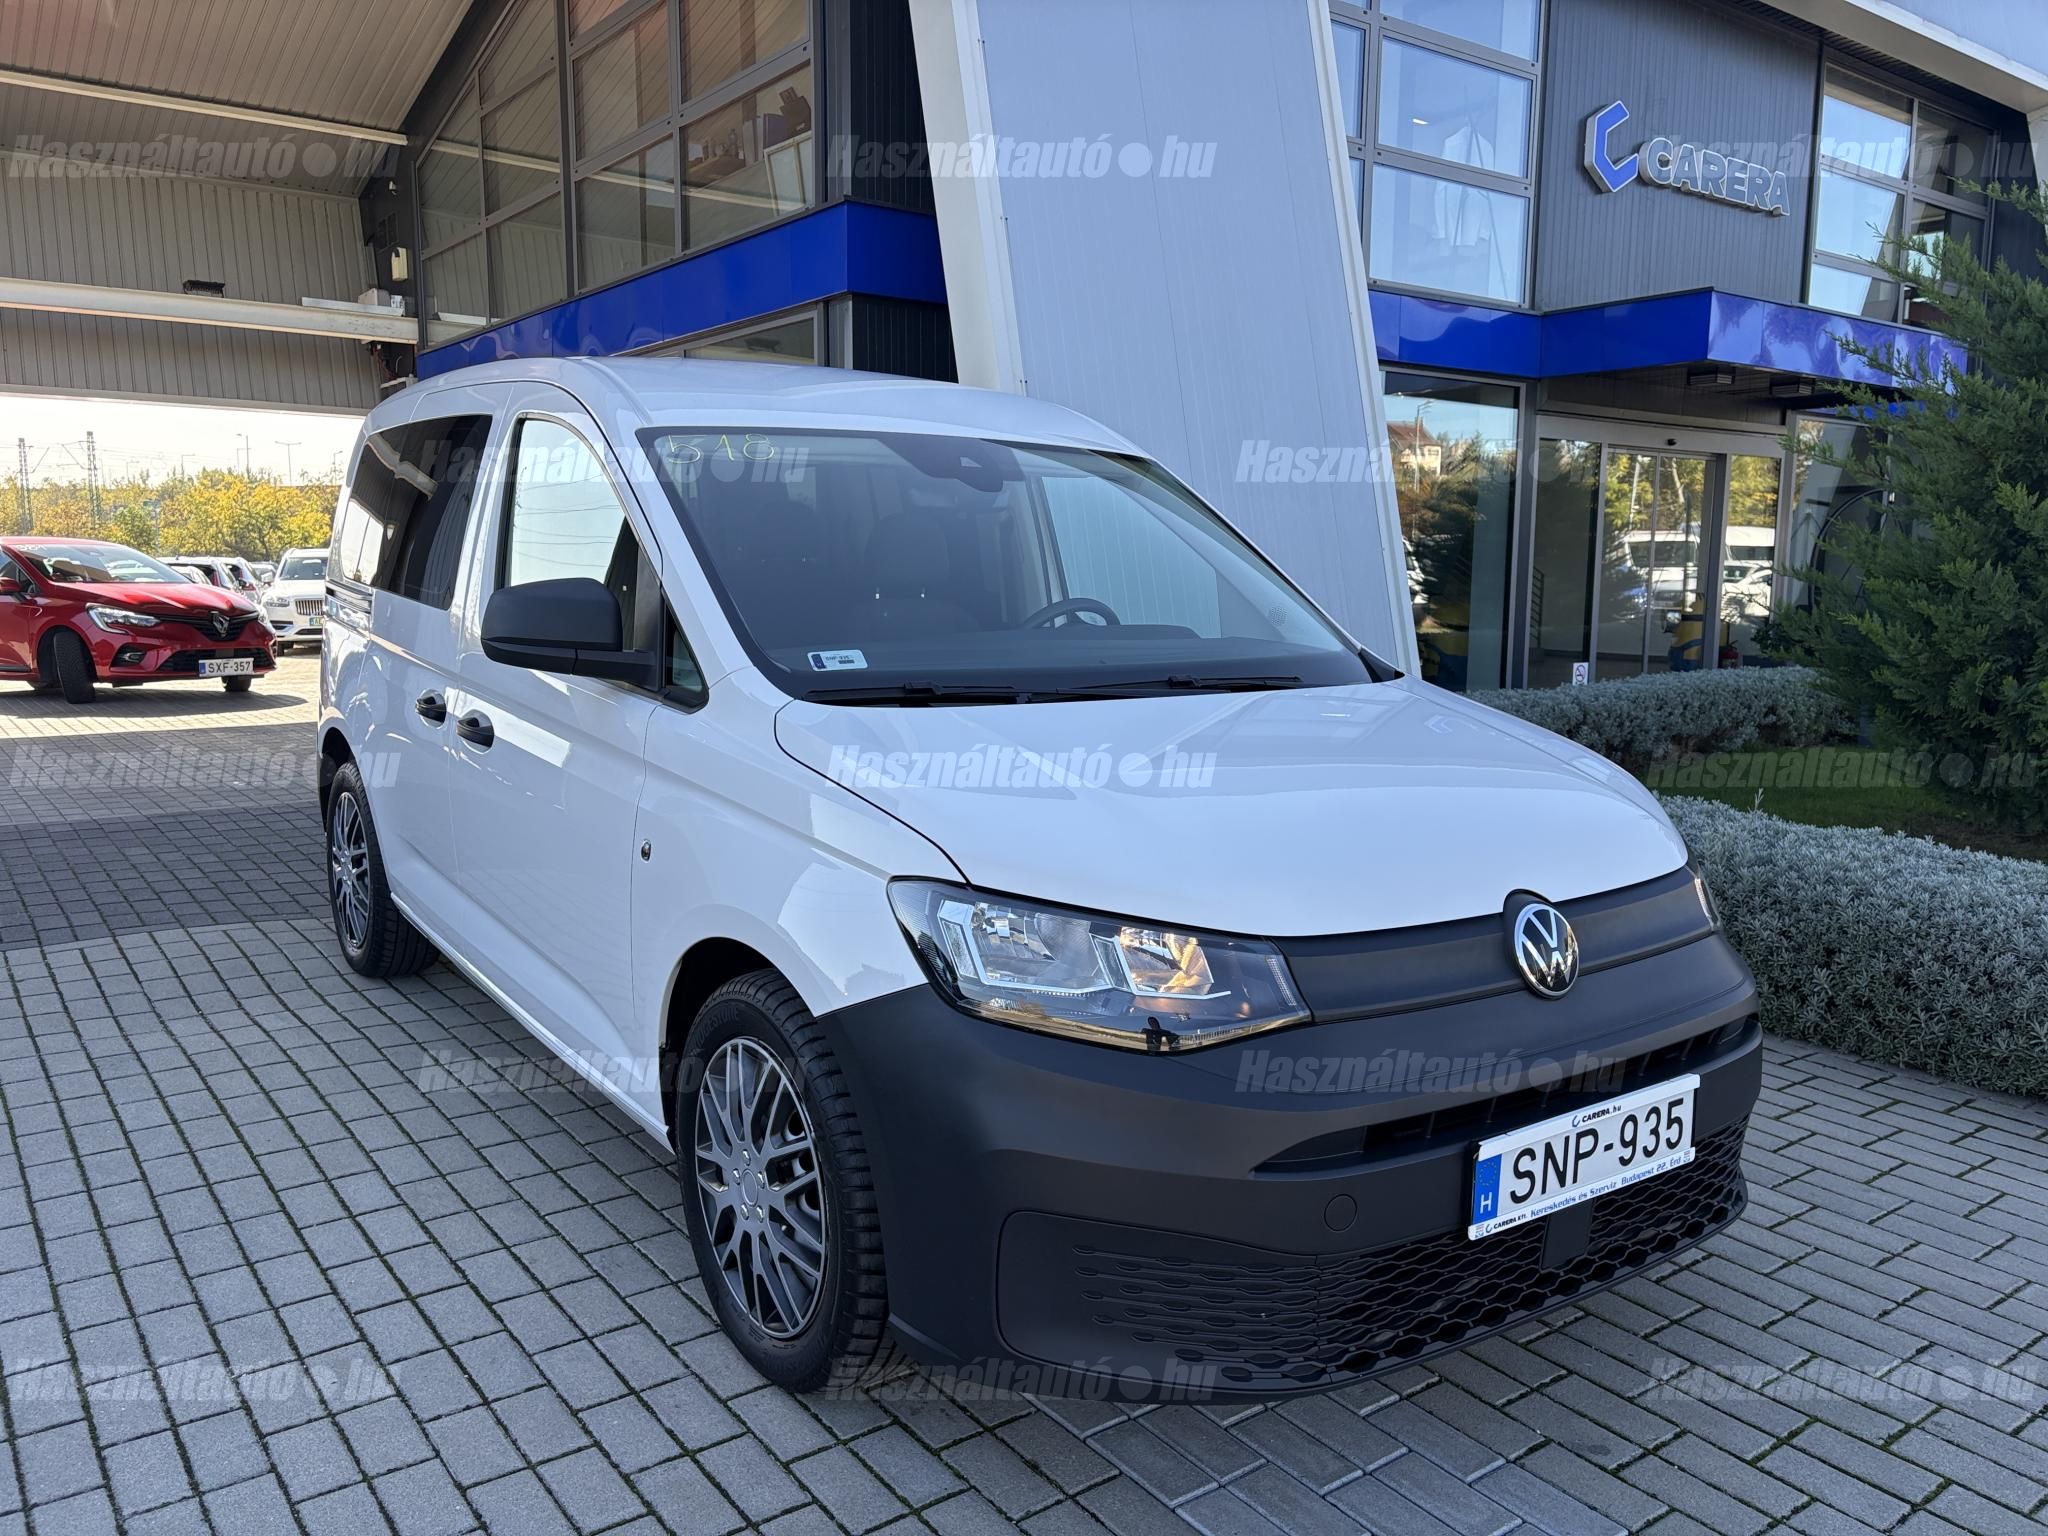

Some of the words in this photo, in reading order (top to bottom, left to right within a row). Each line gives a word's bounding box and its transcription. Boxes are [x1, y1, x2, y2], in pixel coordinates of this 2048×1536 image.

[1646, 137, 1791, 216] CARERA
[668, 433, 775, 464] 518
[208, 661, 251, 673] SXF-357
[1509, 1097, 1685, 1205] SNP-935
[1479, 1191, 1493, 1215] H
[1493, 1216, 1517, 1230] CARERA
[1530, 1195, 1577, 1219] Kereskedés
[1590, 1182, 1618, 1197] Szerviz
[1621, 1167, 1655, 1185] Budapest
